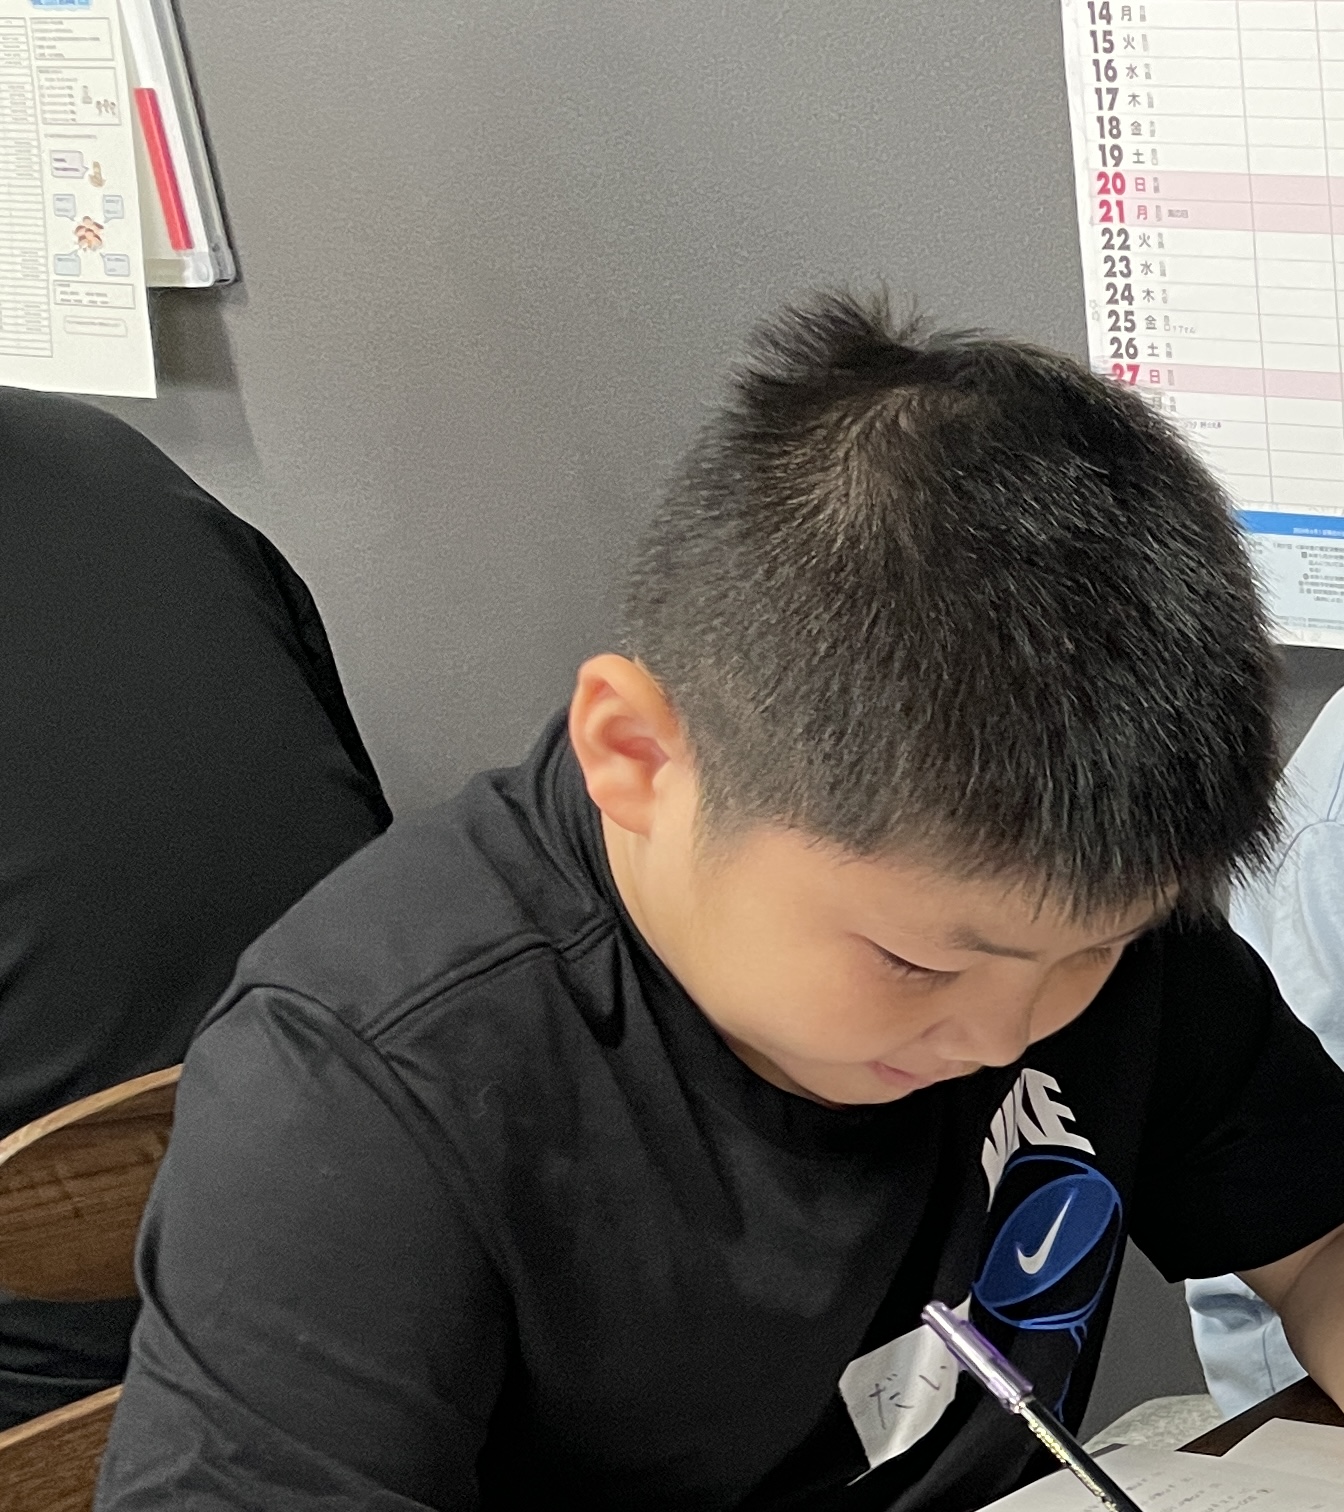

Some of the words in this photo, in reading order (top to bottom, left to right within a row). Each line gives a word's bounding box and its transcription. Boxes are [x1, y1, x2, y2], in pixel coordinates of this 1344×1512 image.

[1088, 1, 1112, 25] 14
[1121, 6, 1132, 21] 月
[1090, 30, 1114, 54] 15
[1123, 34, 1135, 50] 火
[1092, 59, 1117, 82] 16
[1126, 64, 1138, 79] 水
[1095, 88, 1119, 111] 17
[1128, 93, 1140, 107] 木
[1096, 116, 1121, 139] 18
[1131, 121, 1142, 136] 金
[1099, 144, 1123, 167] 19
[1133, 149, 1145, 164] 土
[1097, 172, 1126, 195] 20
[1135, 177, 1146, 192] 日
[1099, 200, 1124, 223] 21
[1137, 205, 1147, 220] 月
[1102, 228, 1130, 251] 22
[1139, 233, 1151, 248] 火
[1104, 255, 1131, 278] 23
[1140, 260, 1153, 275] 水
[1106, 282, 1134, 306] 24
[1142, 288, 1155, 302] 木
[1108, 310, 1136, 333] 25
[1145, 315, 1157, 330] 金
[1110, 336, 1138, 359] 26
[1148, 342, 1159, 357] 土
[1150, 370, 1160, 384] 日
[981, 1068, 1096, 1212] NIKE
